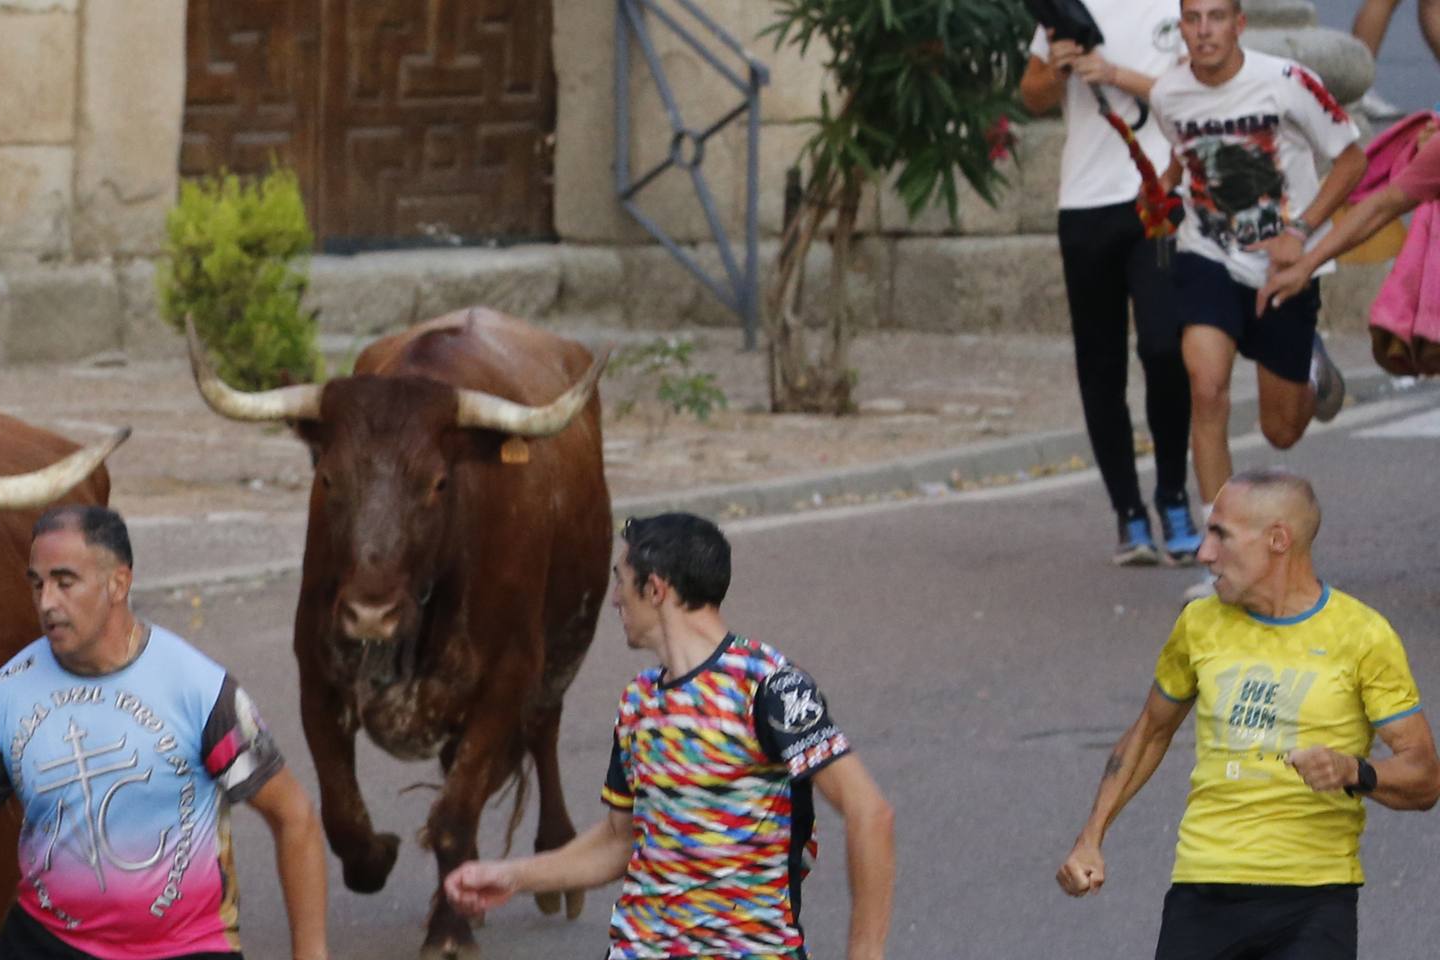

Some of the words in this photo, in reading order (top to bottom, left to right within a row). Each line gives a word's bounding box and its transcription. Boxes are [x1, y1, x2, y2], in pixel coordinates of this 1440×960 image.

[1240, 679, 1280, 705] WE
[113, 690, 165, 734] TORO
[1228, 704, 1277, 729] RUN
